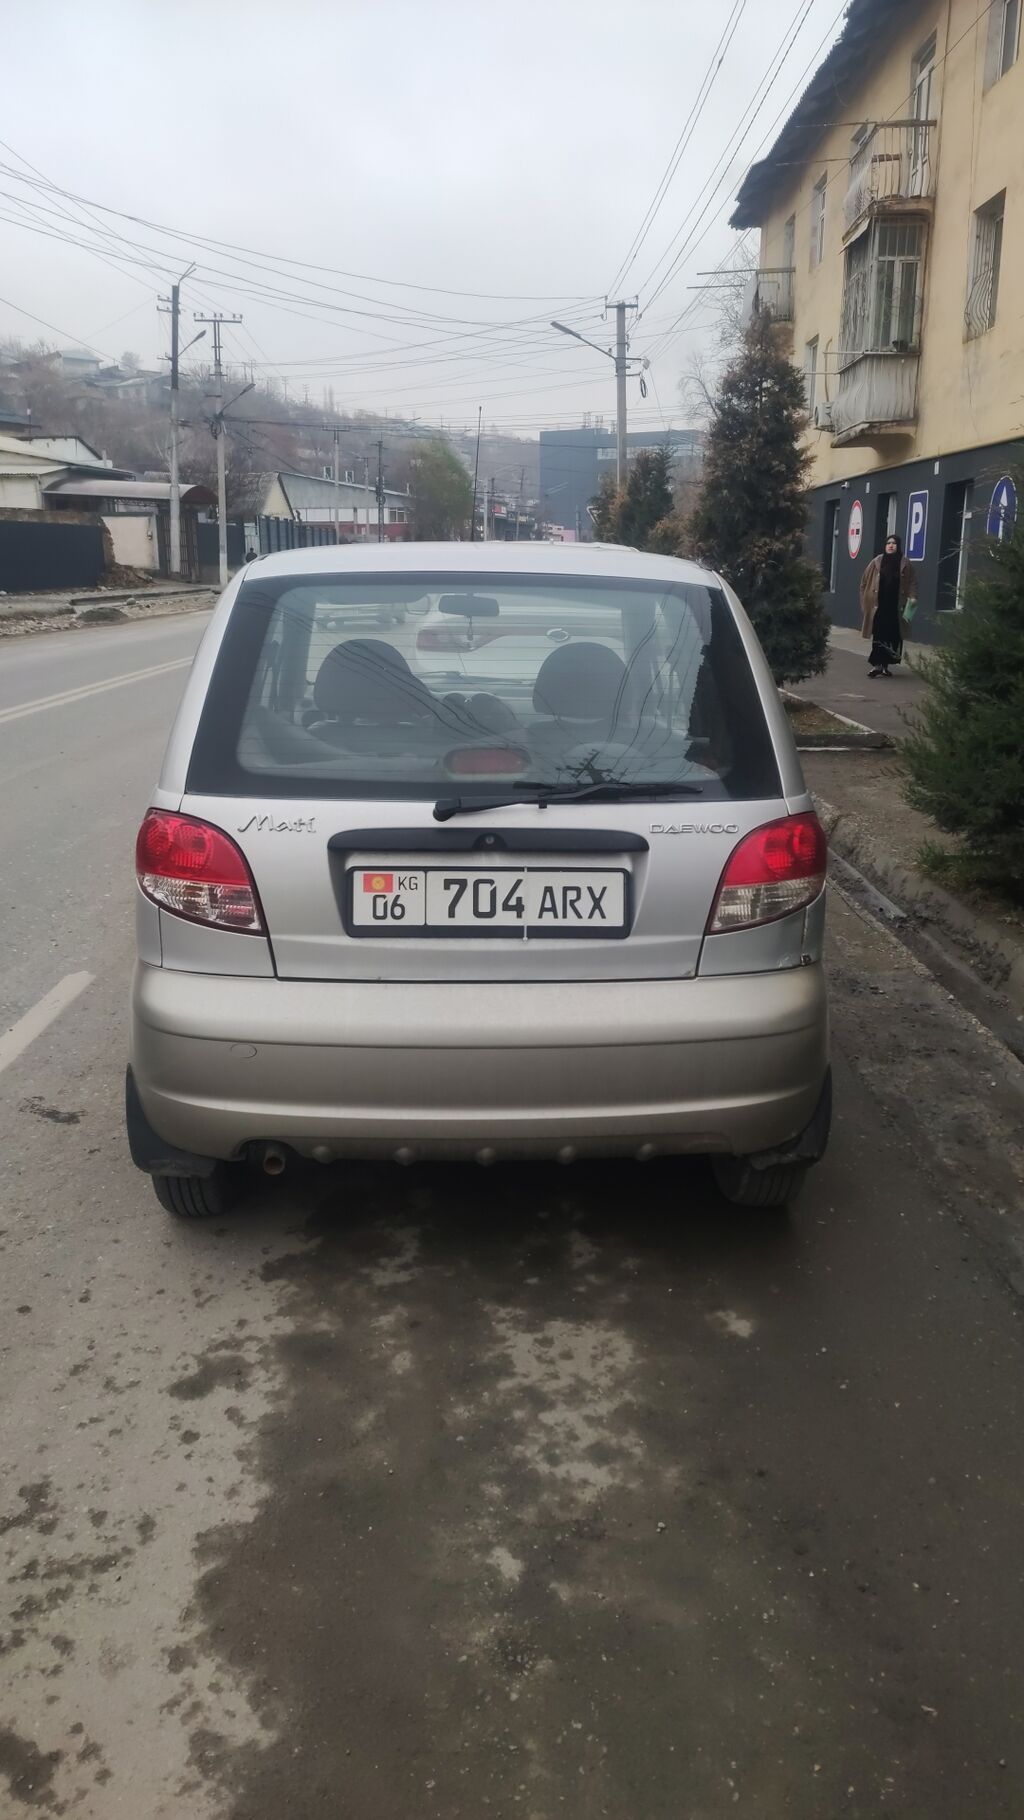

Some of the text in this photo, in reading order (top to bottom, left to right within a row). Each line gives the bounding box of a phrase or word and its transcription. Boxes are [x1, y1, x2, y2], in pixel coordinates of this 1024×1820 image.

[910, 502, 923, 551] P
[649, 823, 739, 834] DAEWOO
[398, 876, 418, 891] KG
[372, 895, 406, 920] 06
[443, 878, 608, 920] 704 ARX
